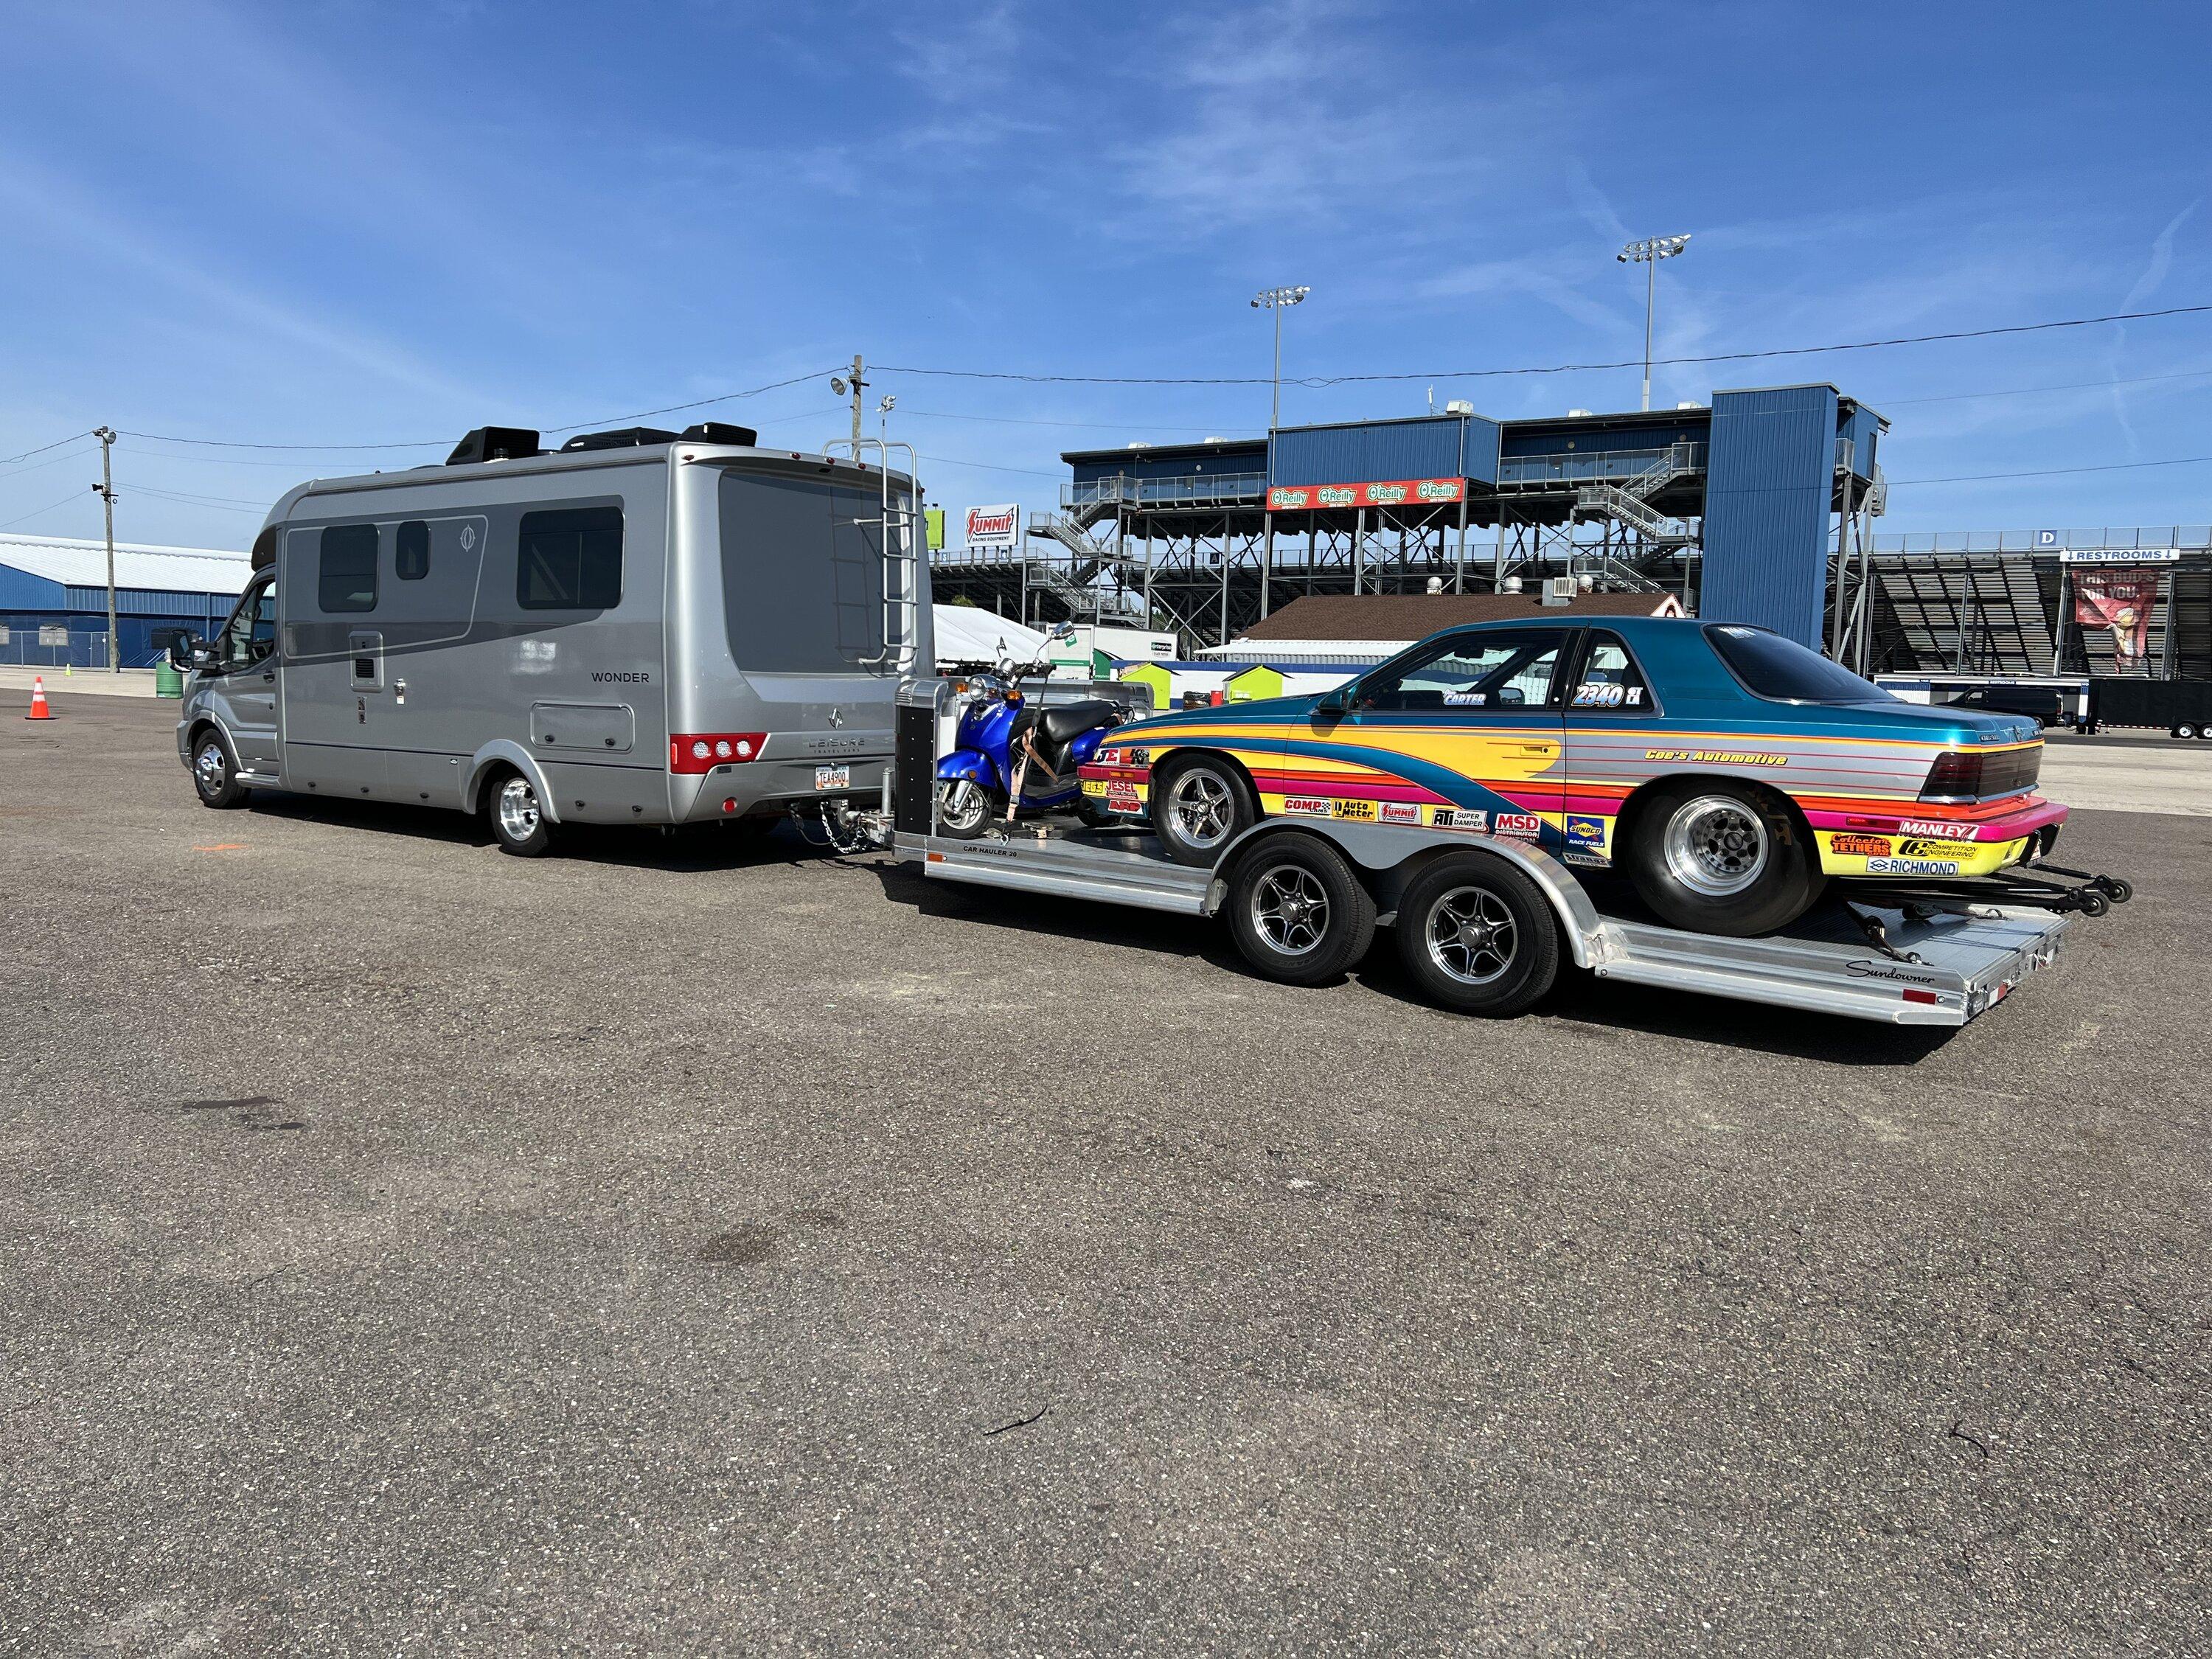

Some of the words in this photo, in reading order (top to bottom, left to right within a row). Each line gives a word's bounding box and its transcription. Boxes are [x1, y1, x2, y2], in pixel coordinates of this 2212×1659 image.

[1319, 488, 1355, 503] O'Reilly
[1368, 486, 1405, 499] O'Reilly
[1419, 483, 1458, 497] O'Reilly
[1273, 490, 1307, 504] O'Reilly
[967, 507, 1014, 543] SUMMIT
[2041, 532, 2055, 543] D
[2076, 550, 2162, 560] RESTROOMS
[2079, 573, 2107, 585] THIS
[2081, 588, 2106, 599] FOR
[591, 672, 650, 683] WONDER
[1445, 694, 1486, 705] CARTER
[1572, 684, 1624, 707] 2340
[1097, 749, 1119, 763] JE
[1644, 749, 1689, 761] Coe's
[1691, 751, 1788, 765] Automotive
[1106, 780, 1137, 793] JESEL
[1109, 801, 1141, 812] ARP
[1284, 799, 1322, 810] COMP
[1343, 801, 1368, 810] Auto
[1343, 809, 1374, 818] Meter
[1382, 803, 1417, 821] SUMMIT
[1457, 812, 1480, 820] SUPER
[1454, 819, 1483, 827] DAMPER
[1497, 814, 1539, 830] MSD
[1495, 829, 1538, 838] DISTRIBUTOR
[1571, 826, 1601, 834] SUNOCO
[1902, 821, 1967, 838] MANLEY
[1832, 833, 1891, 845] Collector
[1832, 842, 1890, 853] TETHERS
[1927, 844, 1978, 852] COMPETITION
[1924, 849, 1975, 858] ENGINEERING
[1890, 860, 1956, 875] RICHMOND
[1846, 960, 1935, 984] Sundowner
